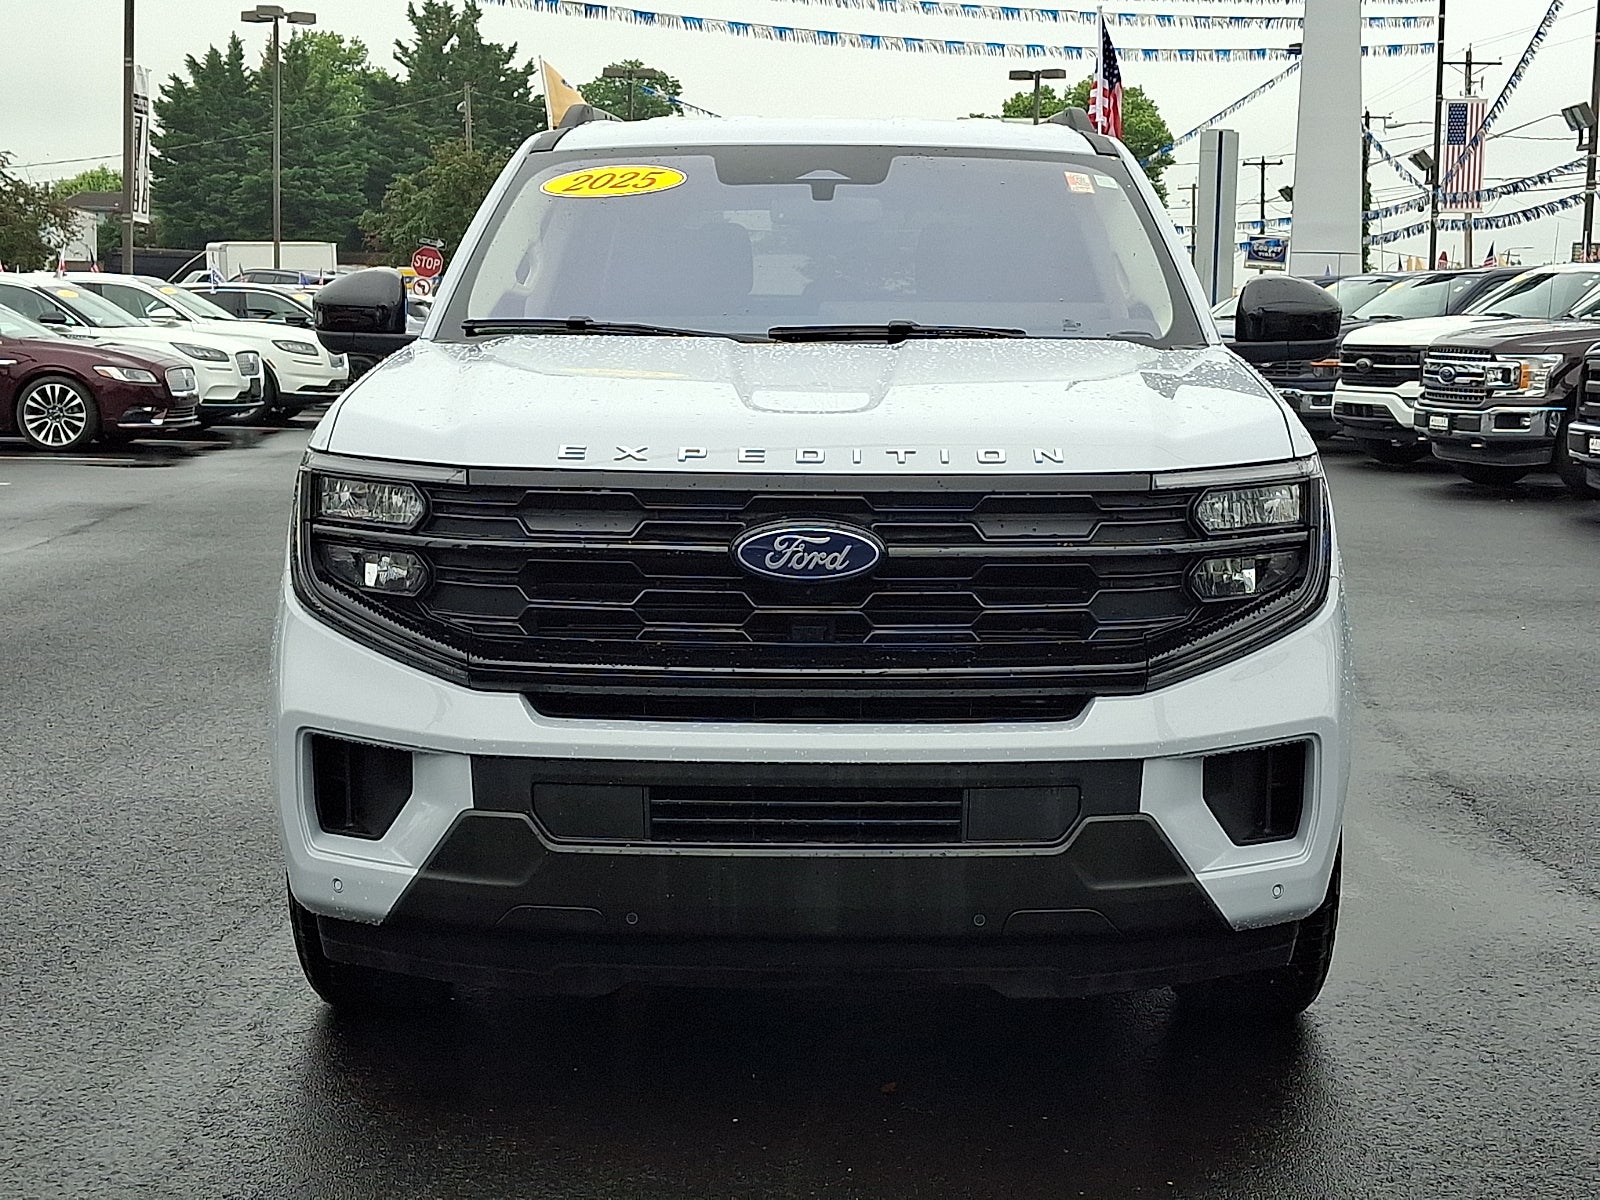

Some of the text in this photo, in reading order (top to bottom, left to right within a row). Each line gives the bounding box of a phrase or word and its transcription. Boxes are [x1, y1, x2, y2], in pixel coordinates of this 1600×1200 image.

[561, 171, 666, 192] 2025
[413, 254, 441, 270] STOP
[557, 443, 1065, 464] EXPEDITION
[765, 534, 852, 570] Ford
